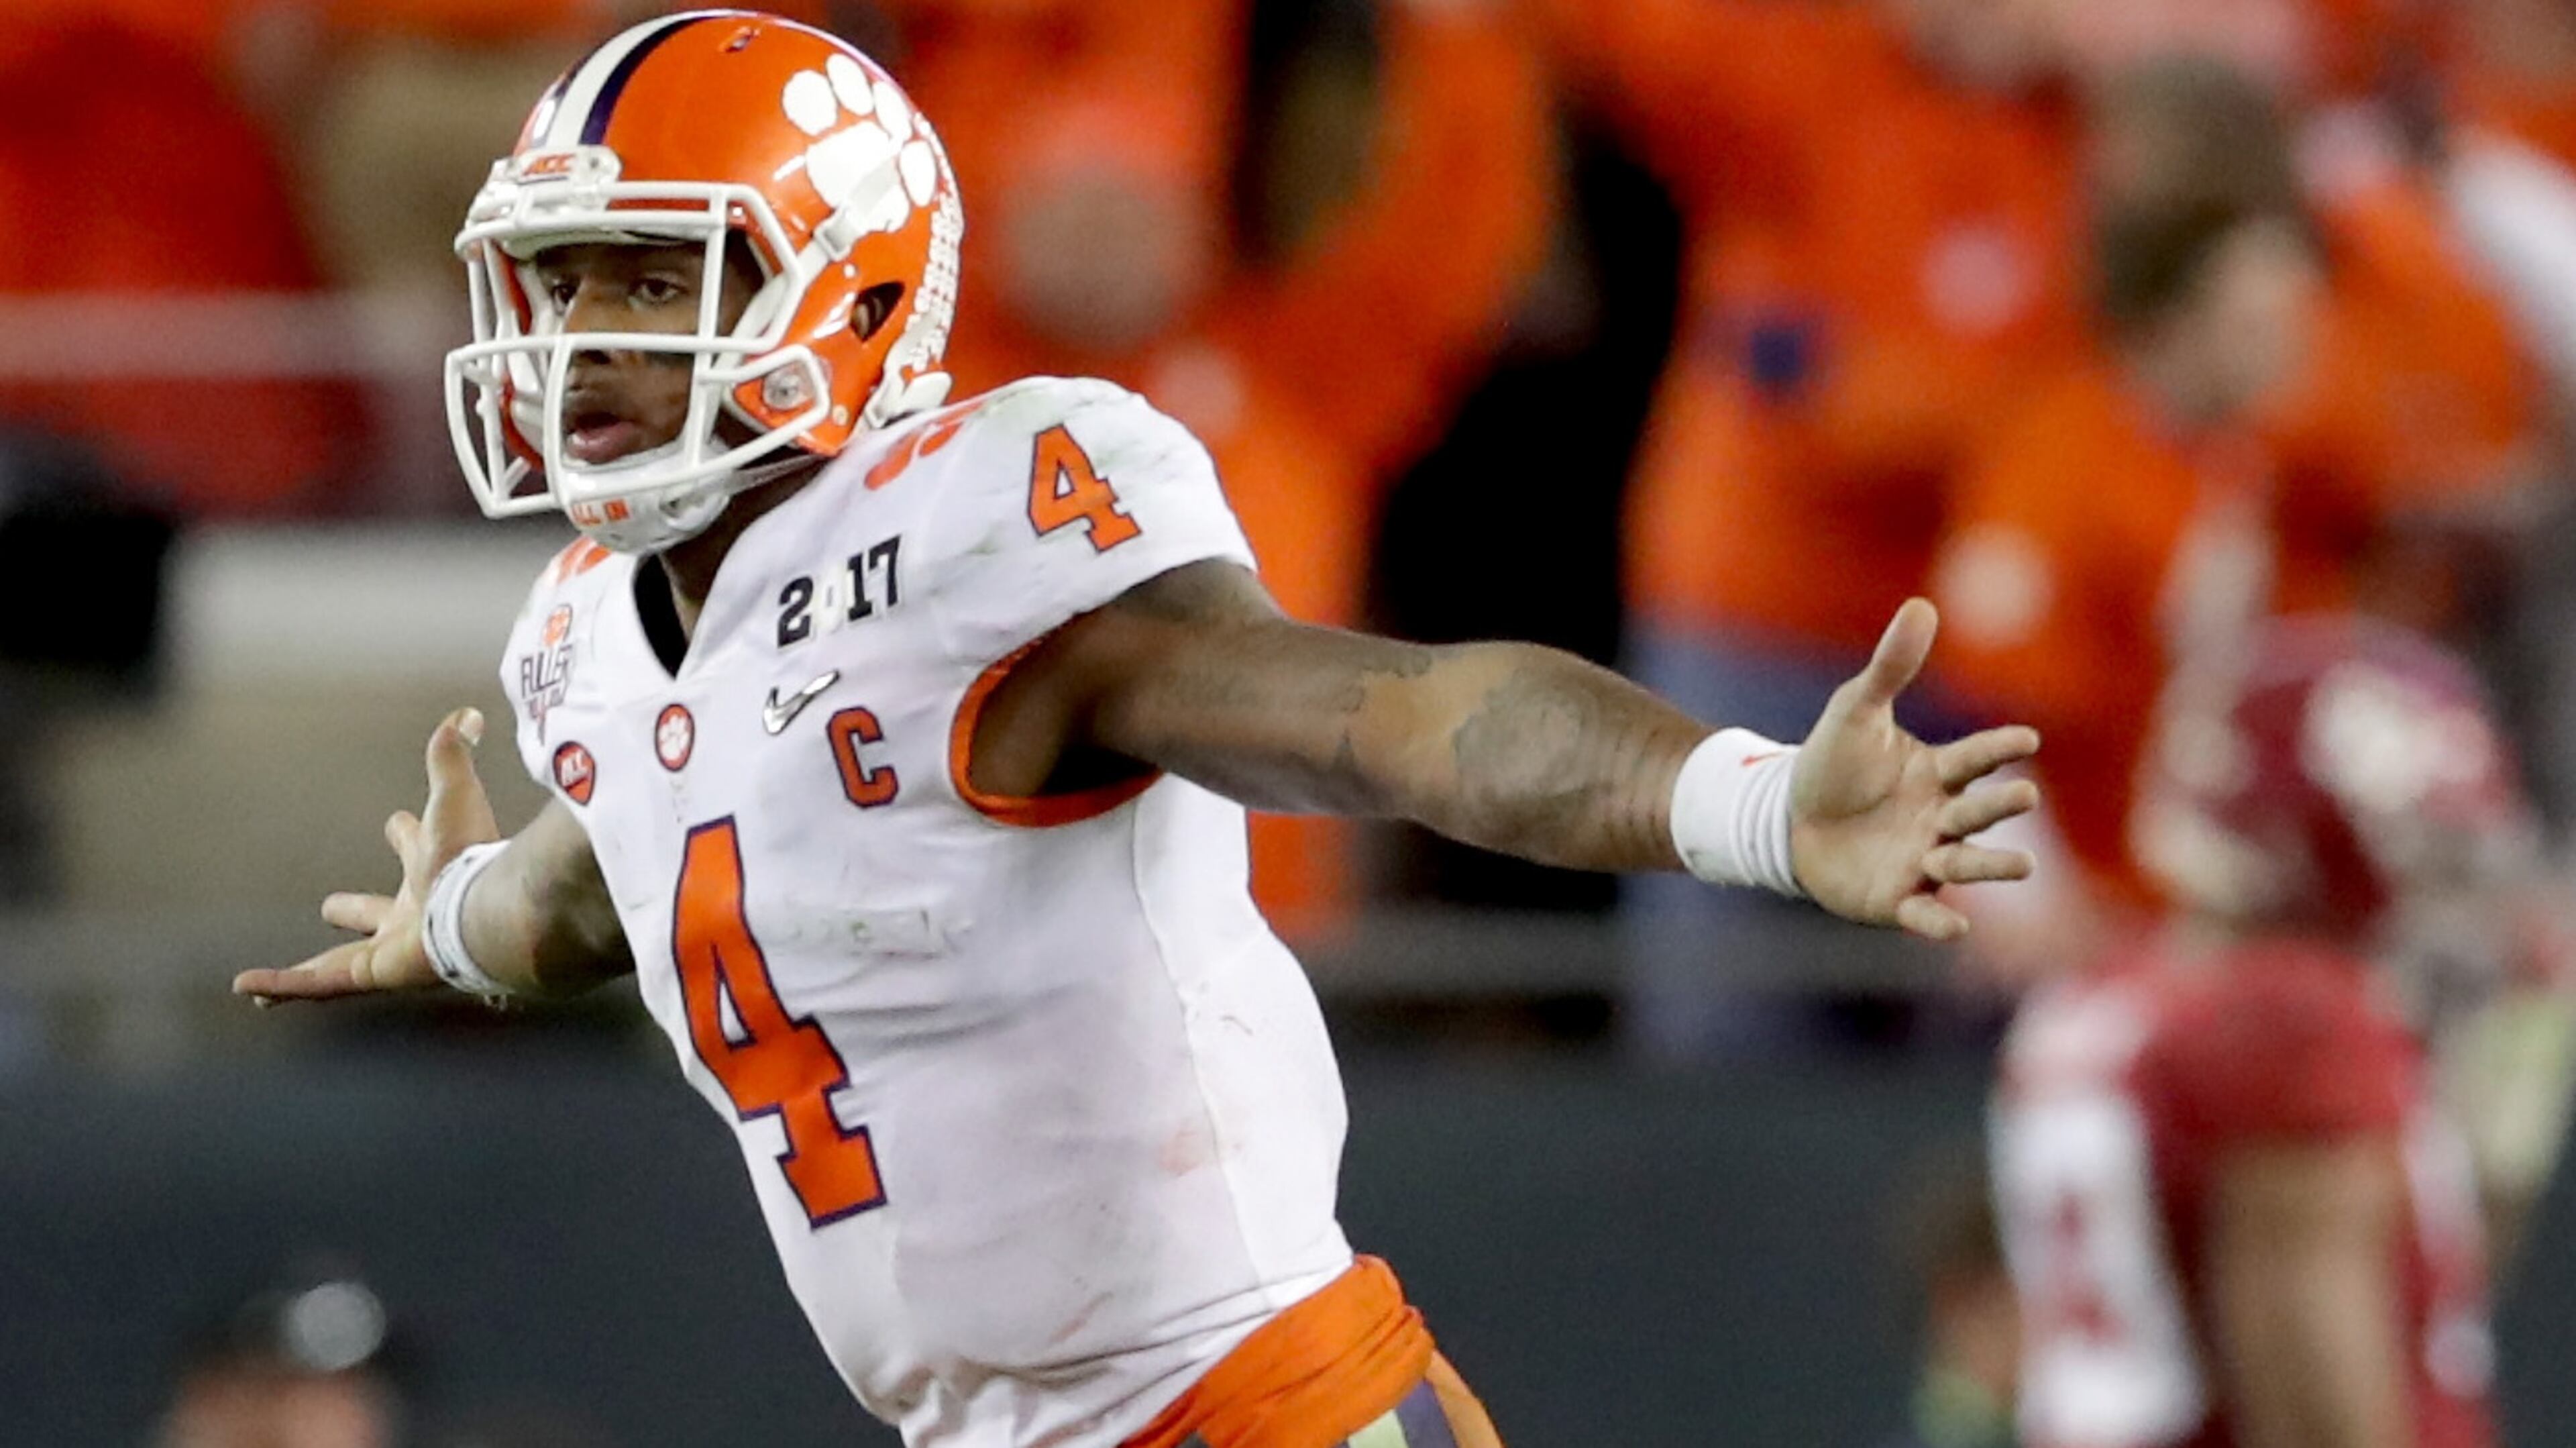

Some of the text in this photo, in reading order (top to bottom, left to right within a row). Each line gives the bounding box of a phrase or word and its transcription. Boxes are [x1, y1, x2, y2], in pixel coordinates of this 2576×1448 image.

[1028, 423, 1143, 554] 4
[826, 706, 900, 809] C
[672, 813, 888, 1229] 4
